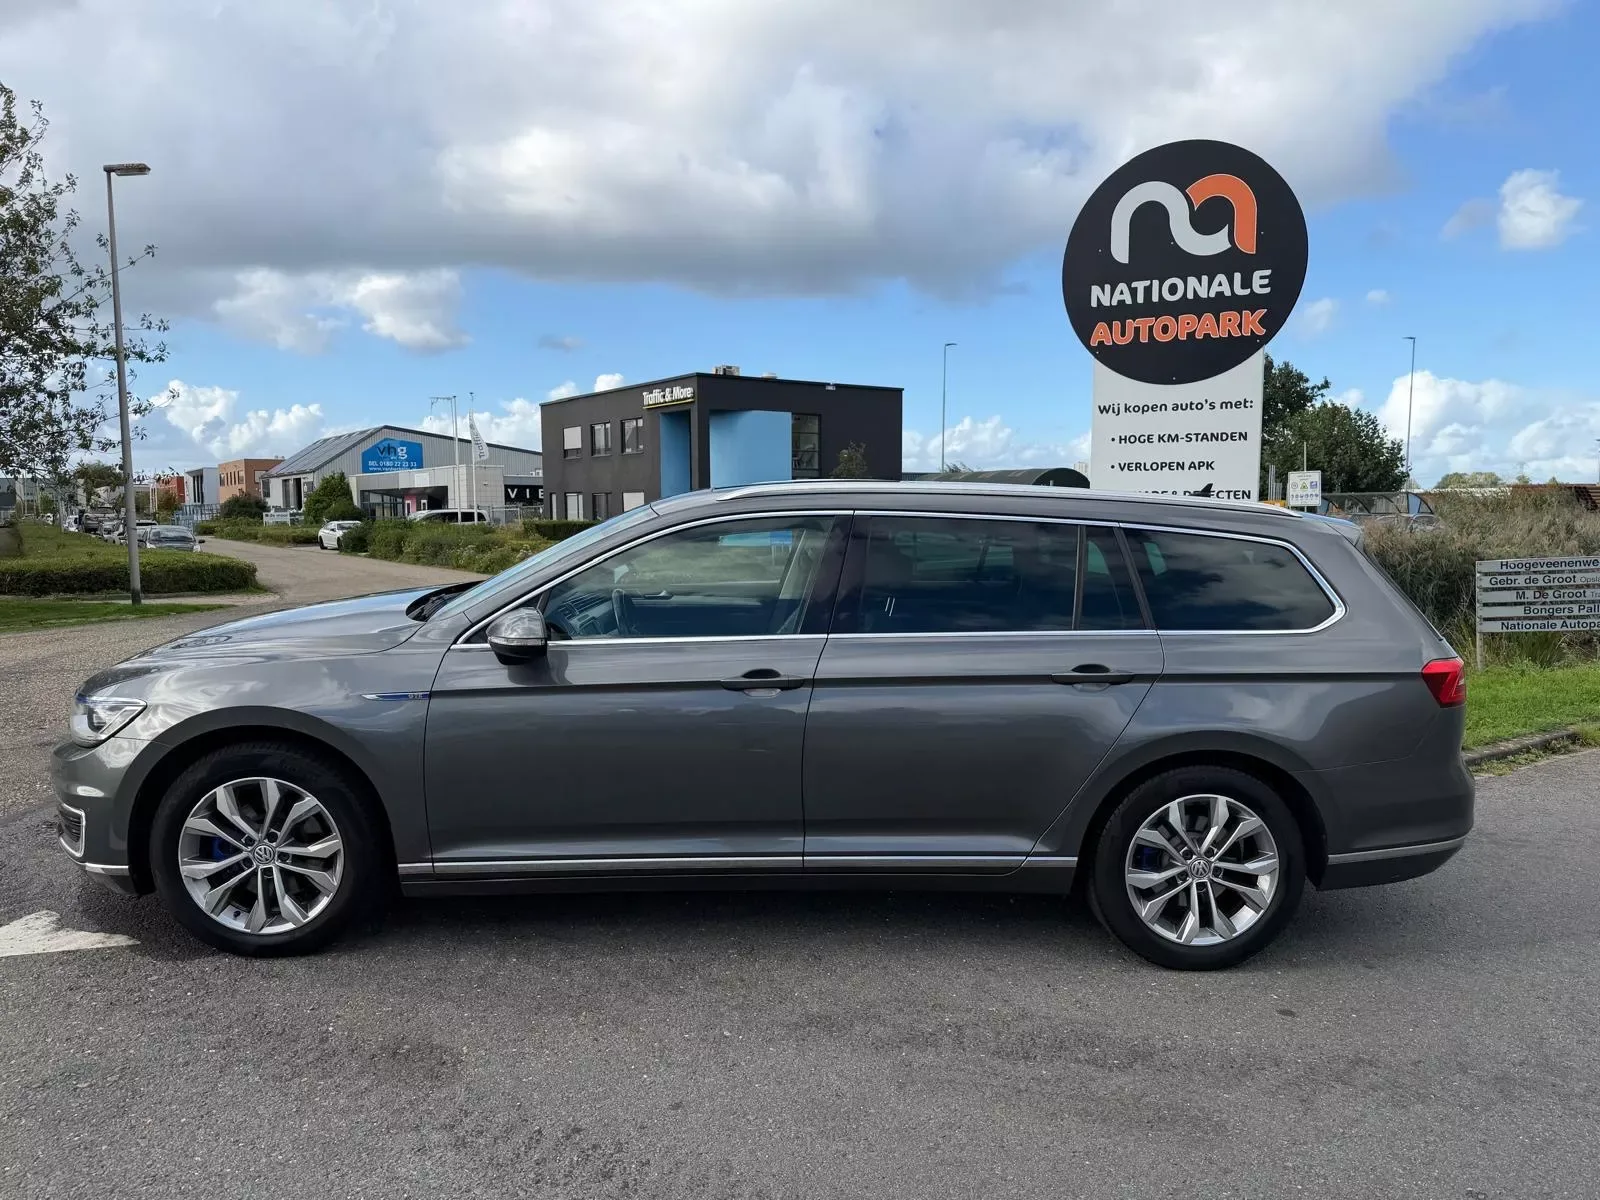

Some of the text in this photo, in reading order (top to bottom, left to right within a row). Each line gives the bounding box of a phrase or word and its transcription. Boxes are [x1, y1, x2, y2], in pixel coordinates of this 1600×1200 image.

[1090, 269, 1272, 307] NATIONALE
[1090, 309, 1267, 346] AUTOPARK
[642, 386, 693, 406] Traffic & More
[1098, 397, 1254, 416] Wij kopen auto's met:
[1118, 431, 1248, 445] HOGE KM-STANDEN
[377, 443, 408, 459] vhg
[1118, 460, 1215, 472] VERLOPEN APK
[1489, 577, 1521, 586] Gebr.
[1524, 575, 1539, 585] de
[1542, 574, 1577, 585] Groot
[1515, 590, 1530, 600] M.
[1533, 590, 1549, 599] De
[1552, 589, 1587, 599] Groot
[1523, 605, 1574, 616] Bongers
[1500, 621, 1558, 630] Nationale
